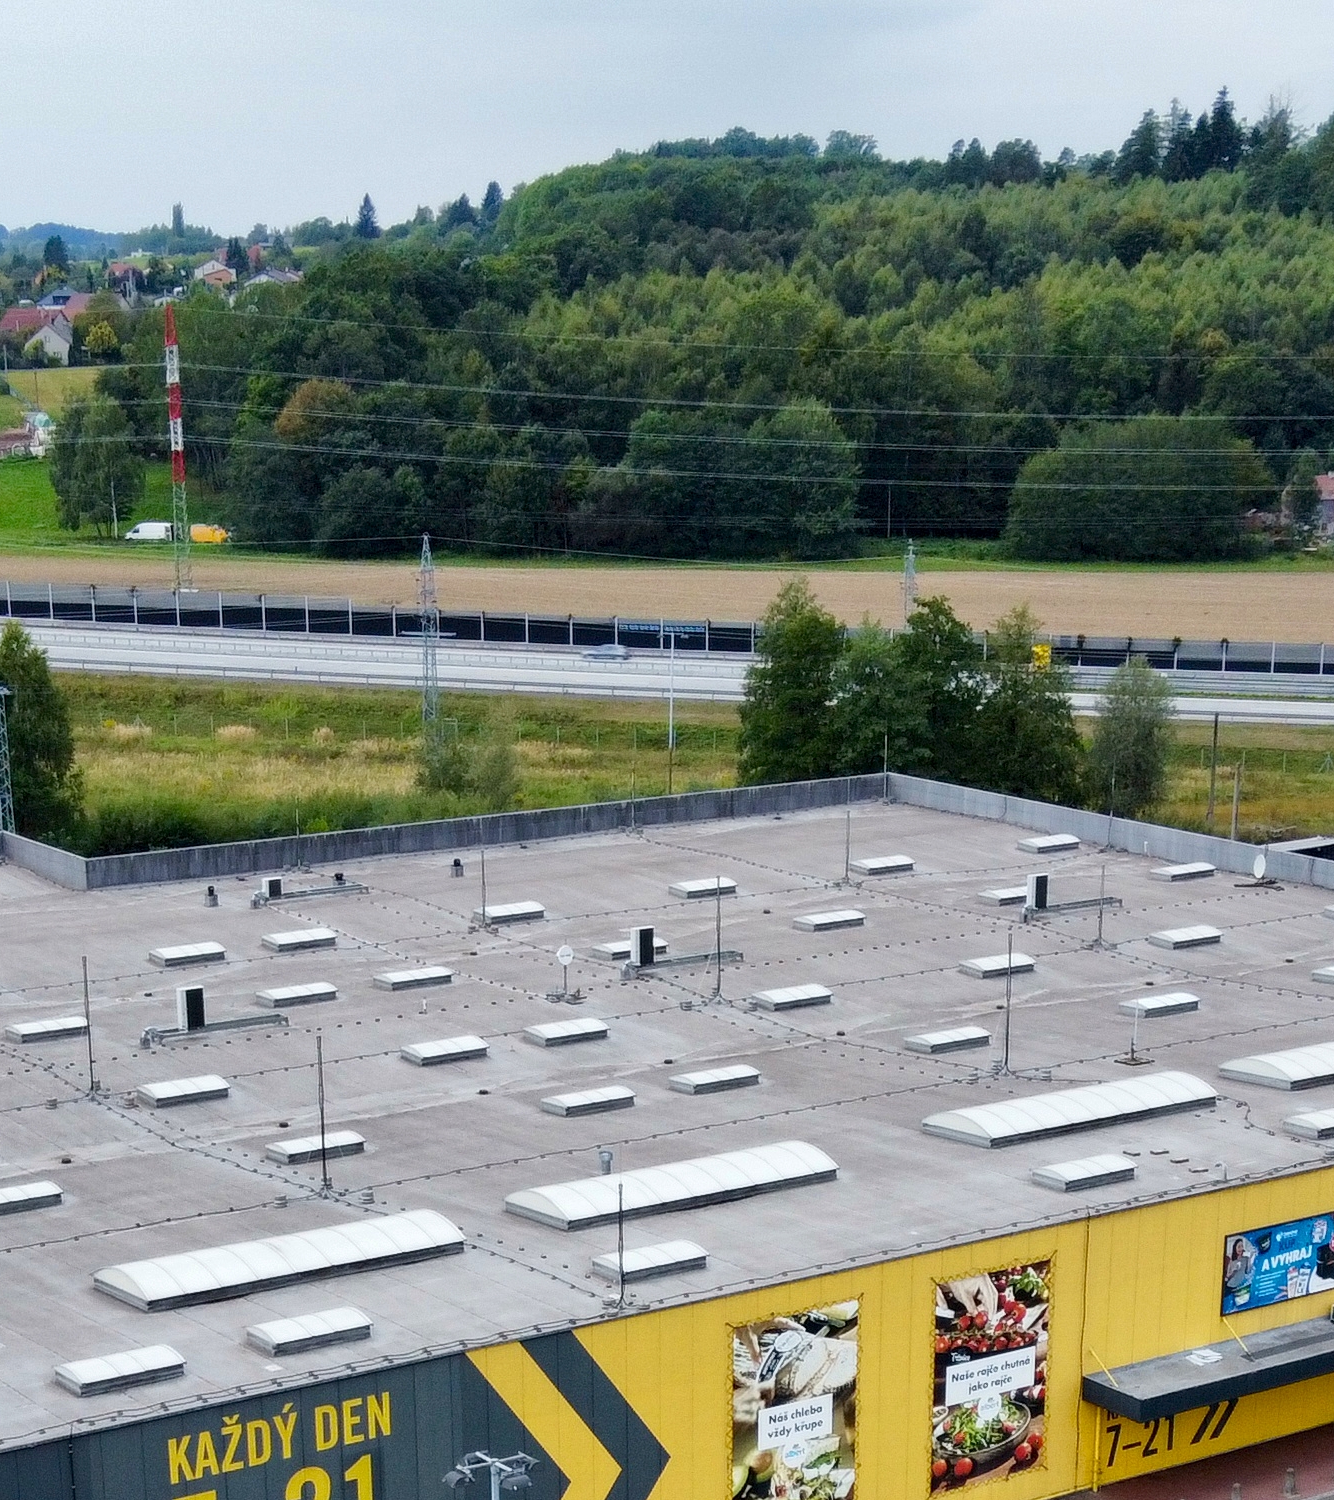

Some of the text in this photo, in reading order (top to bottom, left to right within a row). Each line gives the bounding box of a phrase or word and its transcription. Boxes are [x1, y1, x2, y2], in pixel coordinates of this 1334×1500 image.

[1261, 1244, 1313, 1272] A VYHRAJ
[951, 1355, 1031, 1383] Naše rajče chutná
[968, 1374, 1012, 1395] jako rajče
[768, 1404, 823, 1425] Náš chleba
[167, 1390, 392, 1486] KAŽDÝ DEN
[768, 1418, 824, 1440] vždy křupe
